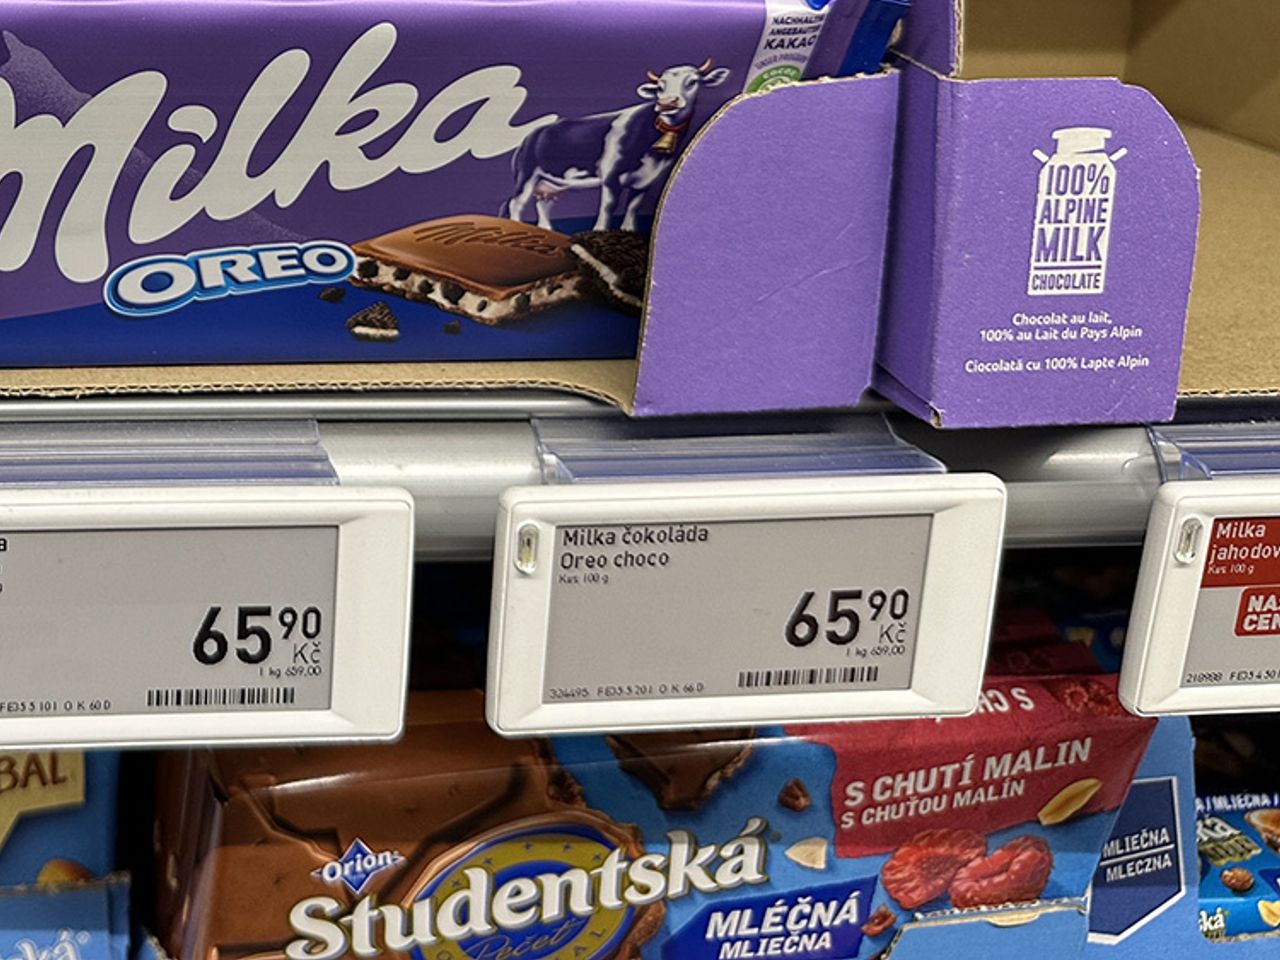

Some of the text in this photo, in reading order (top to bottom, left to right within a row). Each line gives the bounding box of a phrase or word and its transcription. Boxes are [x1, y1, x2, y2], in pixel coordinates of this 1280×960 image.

[1045, 162, 1110, 197] 100%
[1039, 197, 1110, 225] ALPINE
[1034, 226, 1106, 263] MILK
[115, 241, 354, 308] OREO
[1031, 272, 1102, 291] CHOCOLATE
[1012, 311, 1113, 326] Chocolat au lait,
[979, 326, 1143, 343] 100% au Lait du Pays Alpin
[1025, 360, 1041, 371] cu
[1044, 357, 1079, 371] 100%
[1081, 356, 1115, 371] Lapte
[1117, 355, 1150, 371] Alpin
[562, 524, 709, 547] Milka čokoláda
[1216, 521, 1266, 539] Milka
[560, 550, 670, 570] Oreo choco
[558, 574, 579, 584] Kus
[1247, 594, 1280, 612] NA
[784, 589, 863, 648] 65
[192, 605, 273, 666] 65
[878, 621, 908, 645] Kč
[293, 641, 321, 665] Kč
[844, 737, 1093, 807] S CHUTÍ MALIN
[840, 777, 1026, 829] S CHUŤOU MALÍN
[1102, 827, 1170, 858] MLIEČNA
[1106, 853, 1173, 883] MLECZNA
[285, 816, 770, 960] Studentská
[705, 890, 861, 940] MLÉČNÁ
[718, 931, 832, 960] MLIEČNA
